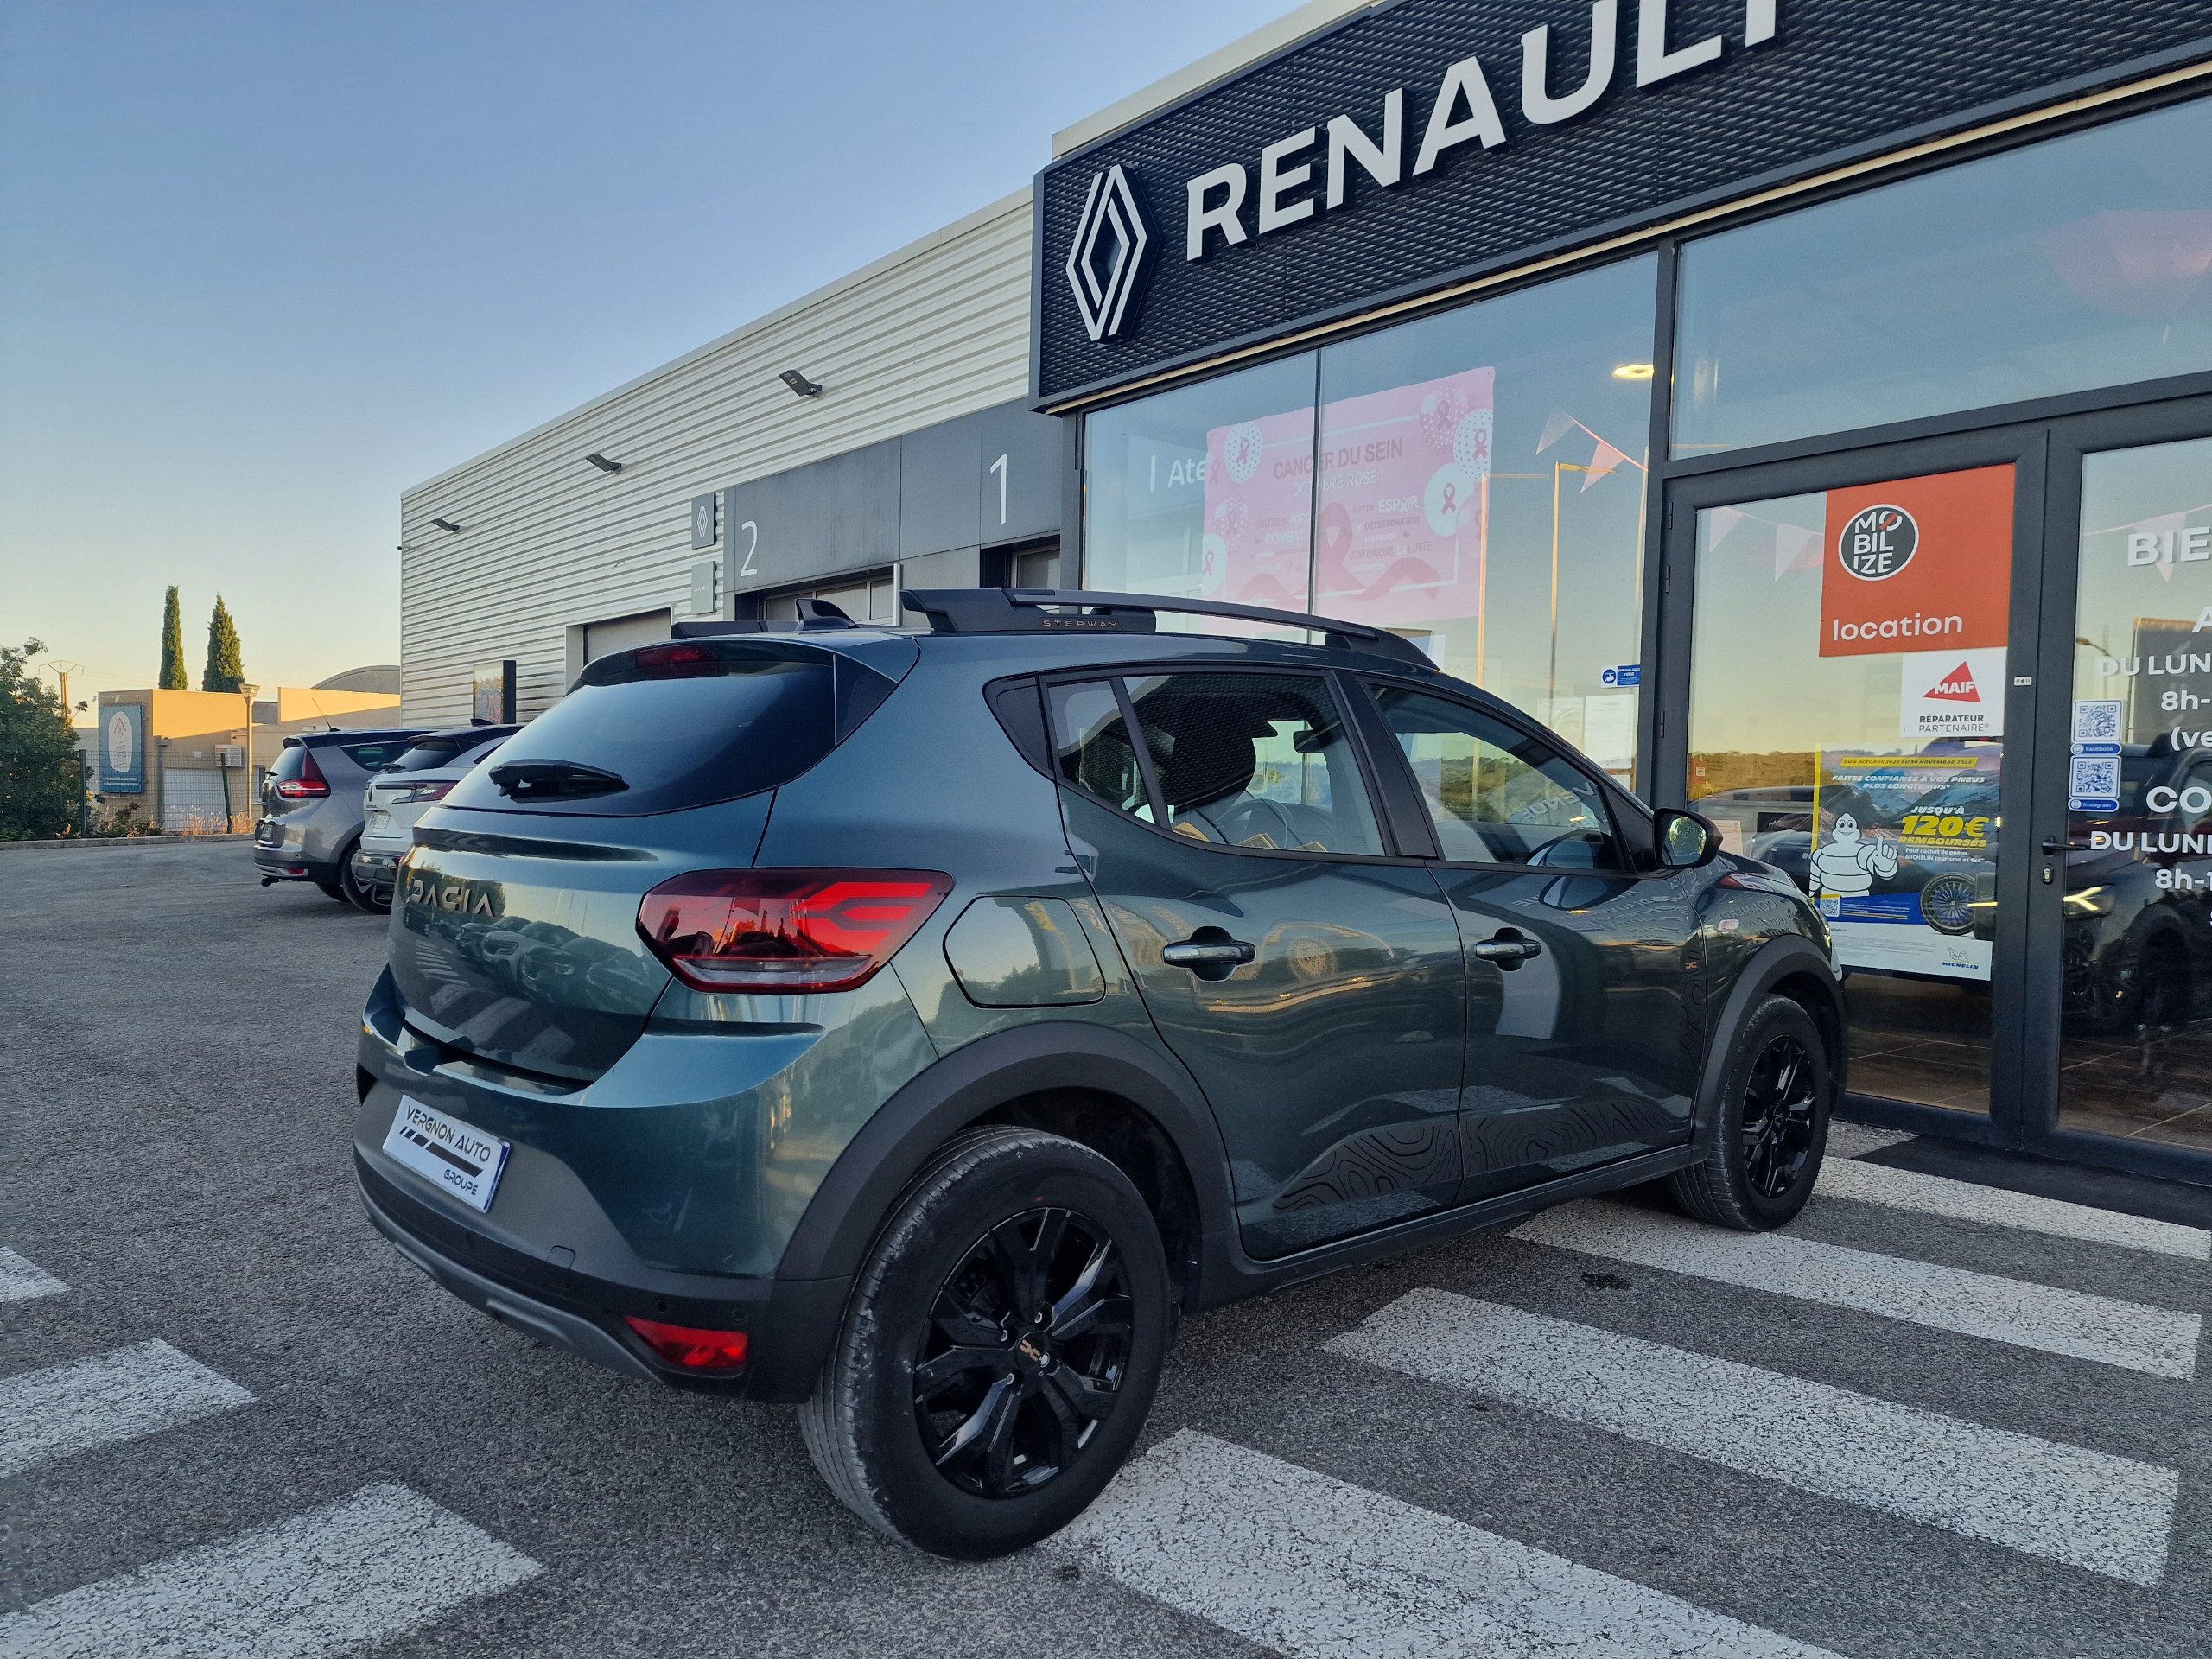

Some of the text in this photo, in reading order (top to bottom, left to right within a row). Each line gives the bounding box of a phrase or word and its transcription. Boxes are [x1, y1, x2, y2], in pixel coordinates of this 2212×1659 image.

[1338, 446, 1362, 468] DU
[1364, 438, 1403, 463] SEIN
[989, 454, 1007, 524] 1
[1293, 469, 1378, 496] OCBRE ROSE
[741, 520, 758, 577] 2
[1265, 529, 1306, 546] COMBAT
[1408, 541, 1432, 554] LUTTE
[2127, 526, 2211, 567] BIE
[1043, 620, 1117, 628] STEPWAY
[1833, 613, 1963, 641] location
[2097, 655, 2140, 677] DU
[1934, 681, 1976, 695] MAIF
[2161, 690, 2211, 711] 8h-
[1919, 713, 1984, 723] RÉPARATEUR
[1910, 805, 1965, 816] JUSQU'À
[1901, 815, 1990, 838] 120€
[1897, 836, 1987, 847] REMBOURSÉS
[2091, 831, 2212, 854] DU LUN
[406, 1104, 491, 1164] VERGNON AUTO
[443, 1167, 480, 1197] GROUPE
